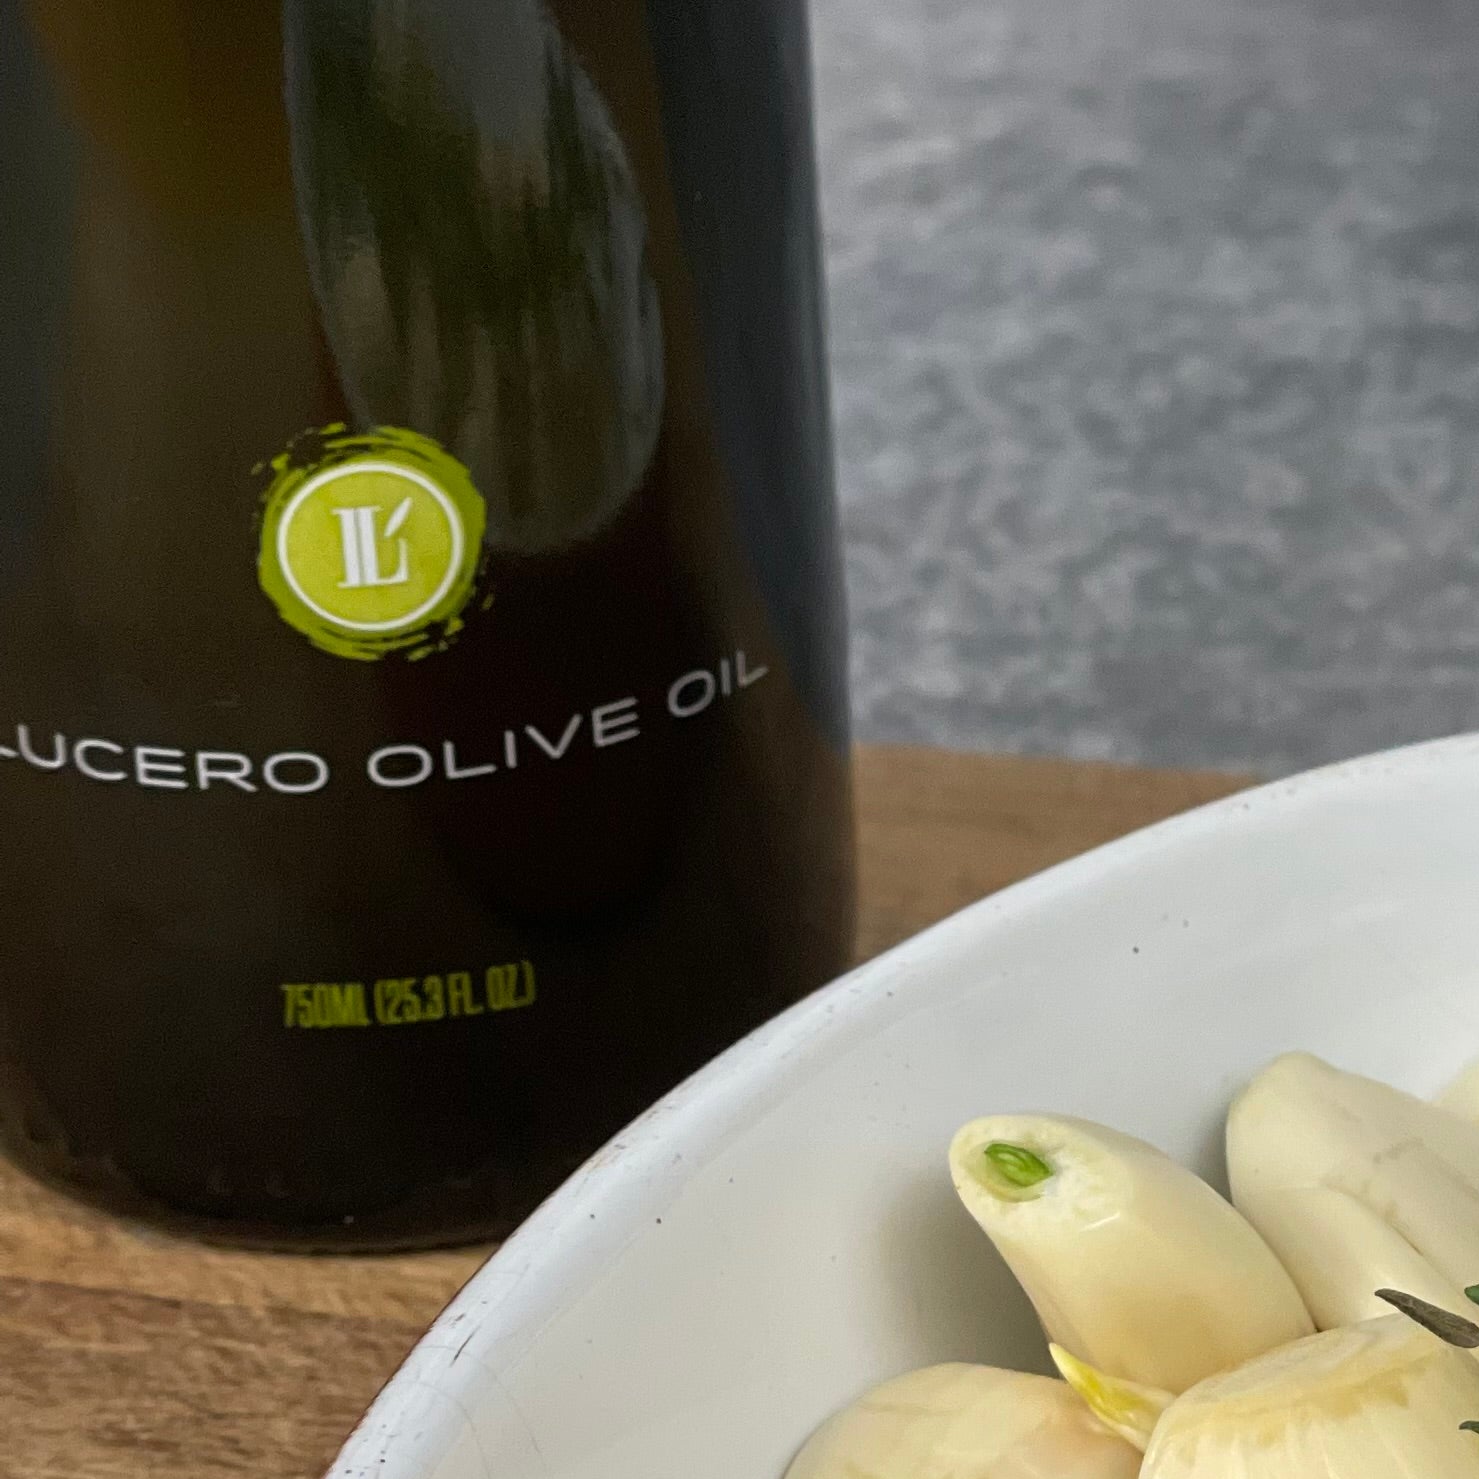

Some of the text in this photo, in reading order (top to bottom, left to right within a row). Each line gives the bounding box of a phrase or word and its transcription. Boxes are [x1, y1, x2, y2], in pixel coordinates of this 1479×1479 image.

[366, 696, 641, 787] OLIVE
[667, 650, 769, 718] OIL
[281, 982, 371, 1028] 750ML
